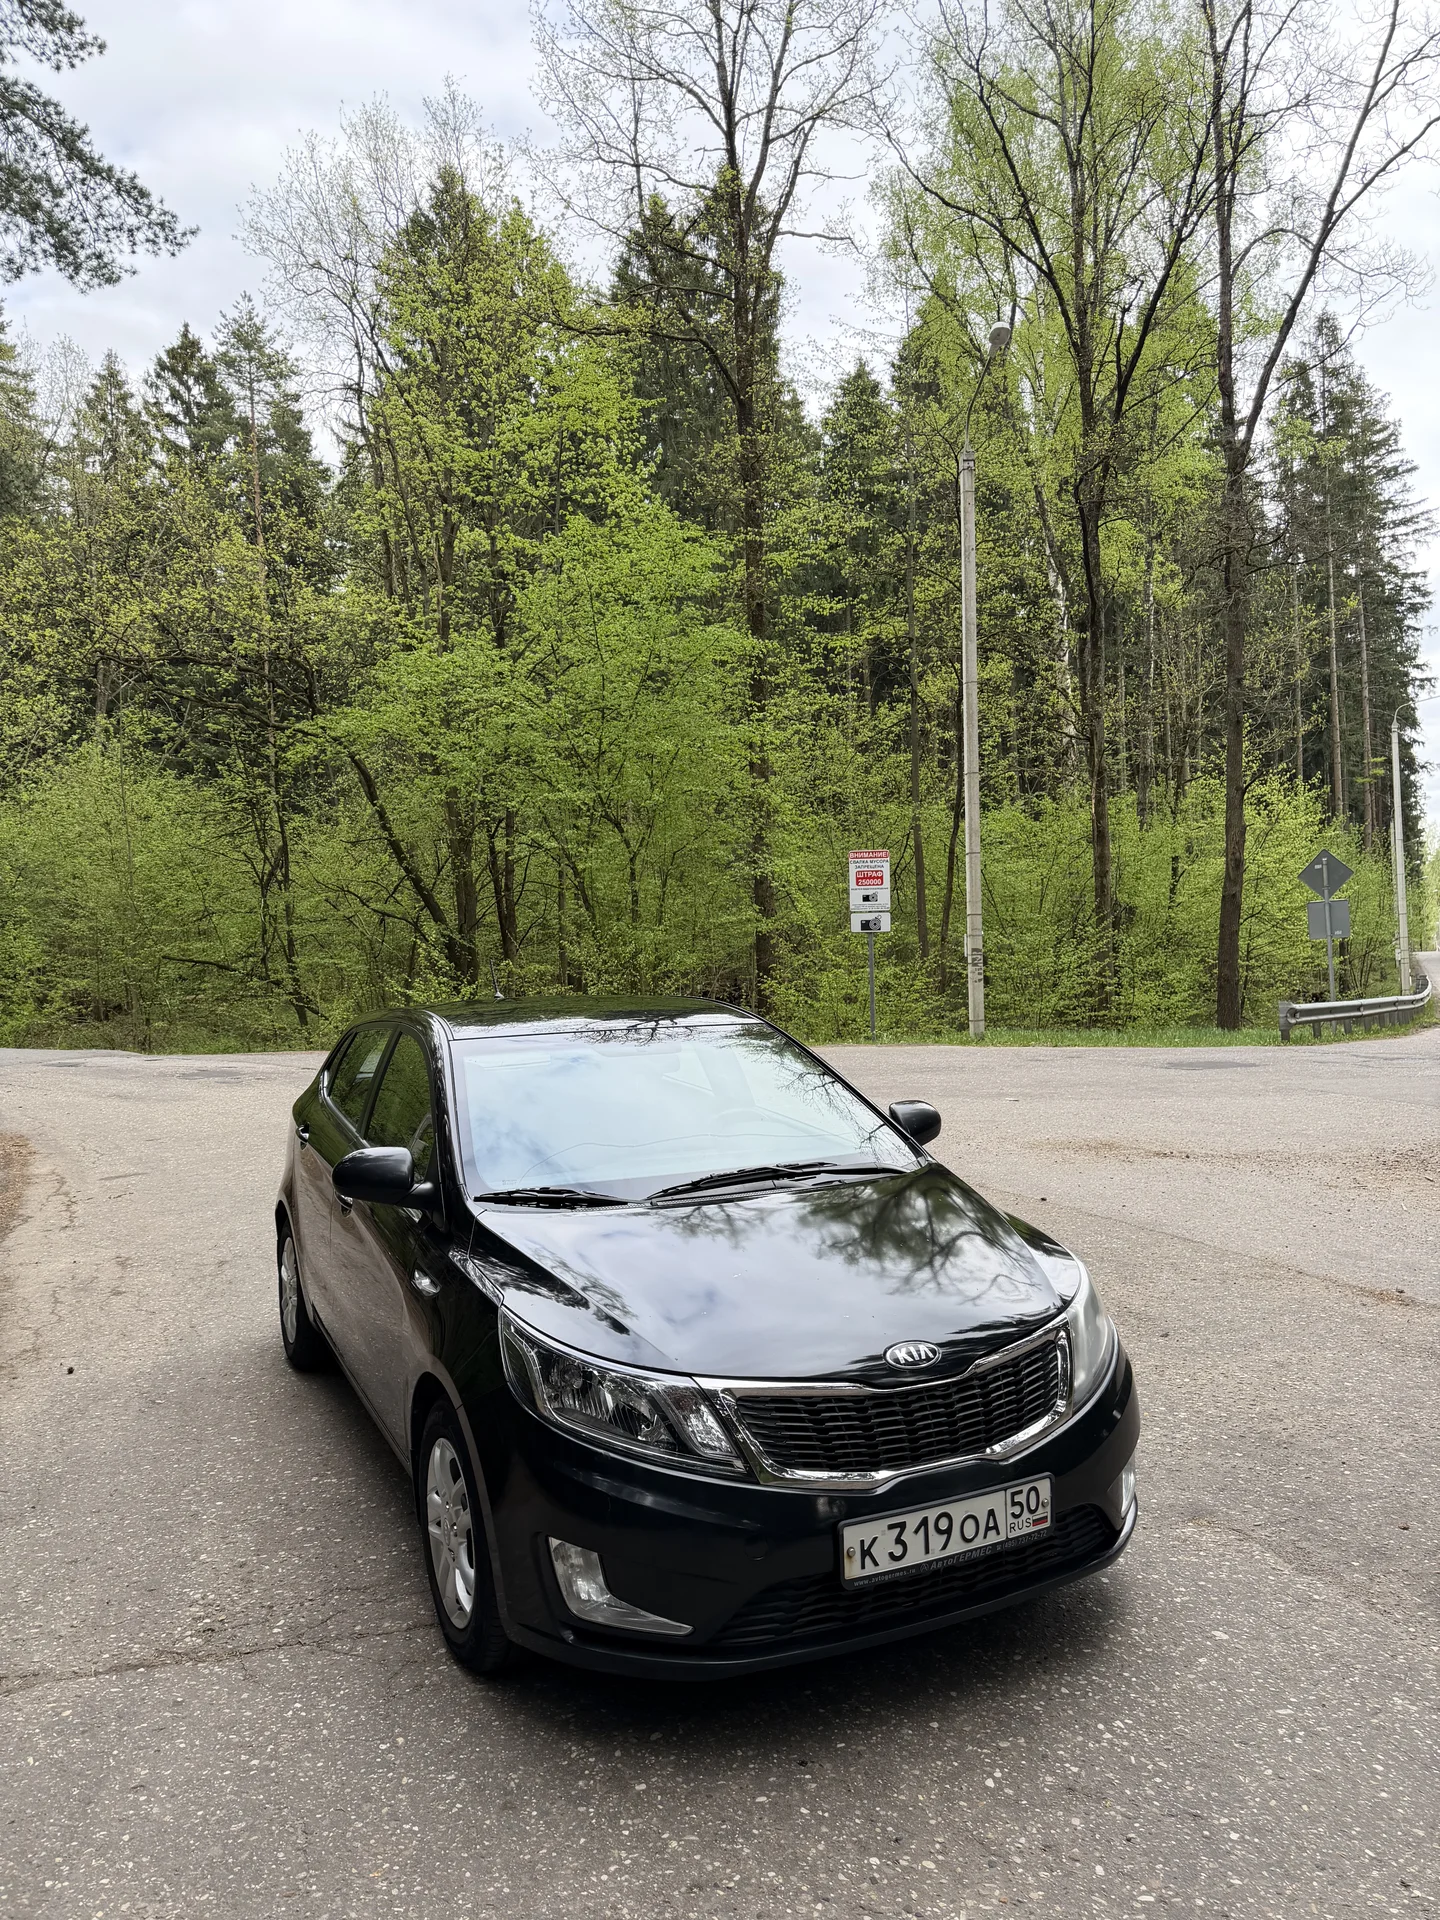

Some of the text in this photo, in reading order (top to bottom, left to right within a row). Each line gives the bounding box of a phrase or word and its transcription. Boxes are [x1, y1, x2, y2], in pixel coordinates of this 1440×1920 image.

[894, 1344, 935, 1364] KIA
[1010, 1485, 1040, 1519] 50
[1009, 1516, 1031, 1533] RUS
[1018, 1529, 1048, 1545] 737-72-72
